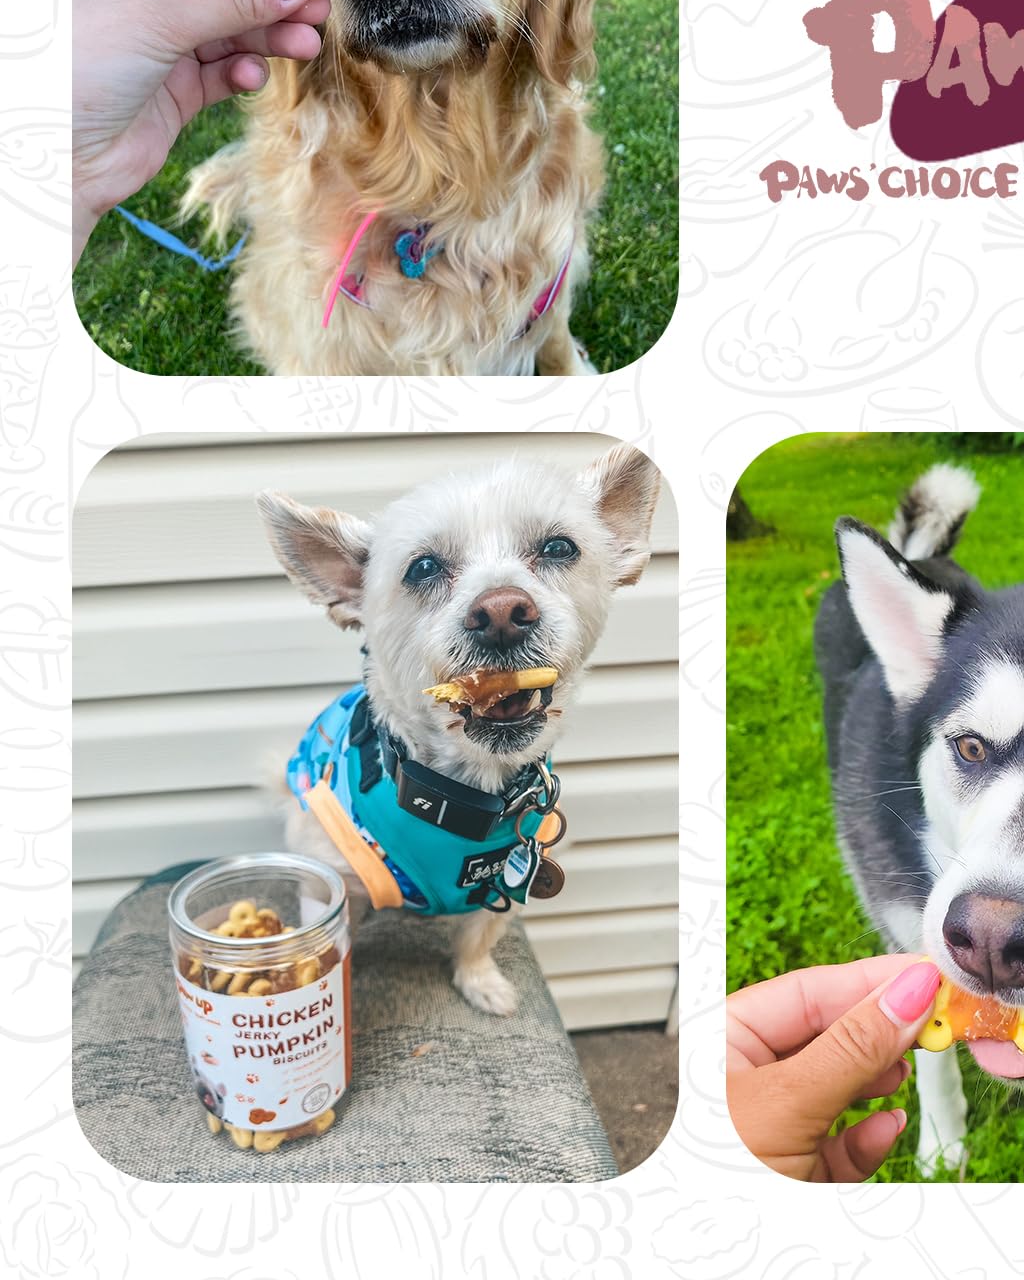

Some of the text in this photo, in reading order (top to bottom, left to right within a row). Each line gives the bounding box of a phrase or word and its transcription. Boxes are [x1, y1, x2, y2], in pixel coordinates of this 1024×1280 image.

[195, 996, 214, 1016] UP
[232, 993, 334, 1029] CHICKEN
[232, 1015, 334, 1059] PUMPKIN
[234, 1031, 282, 1040] JERKY
[273, 1040, 328, 1065] BISCUITS
